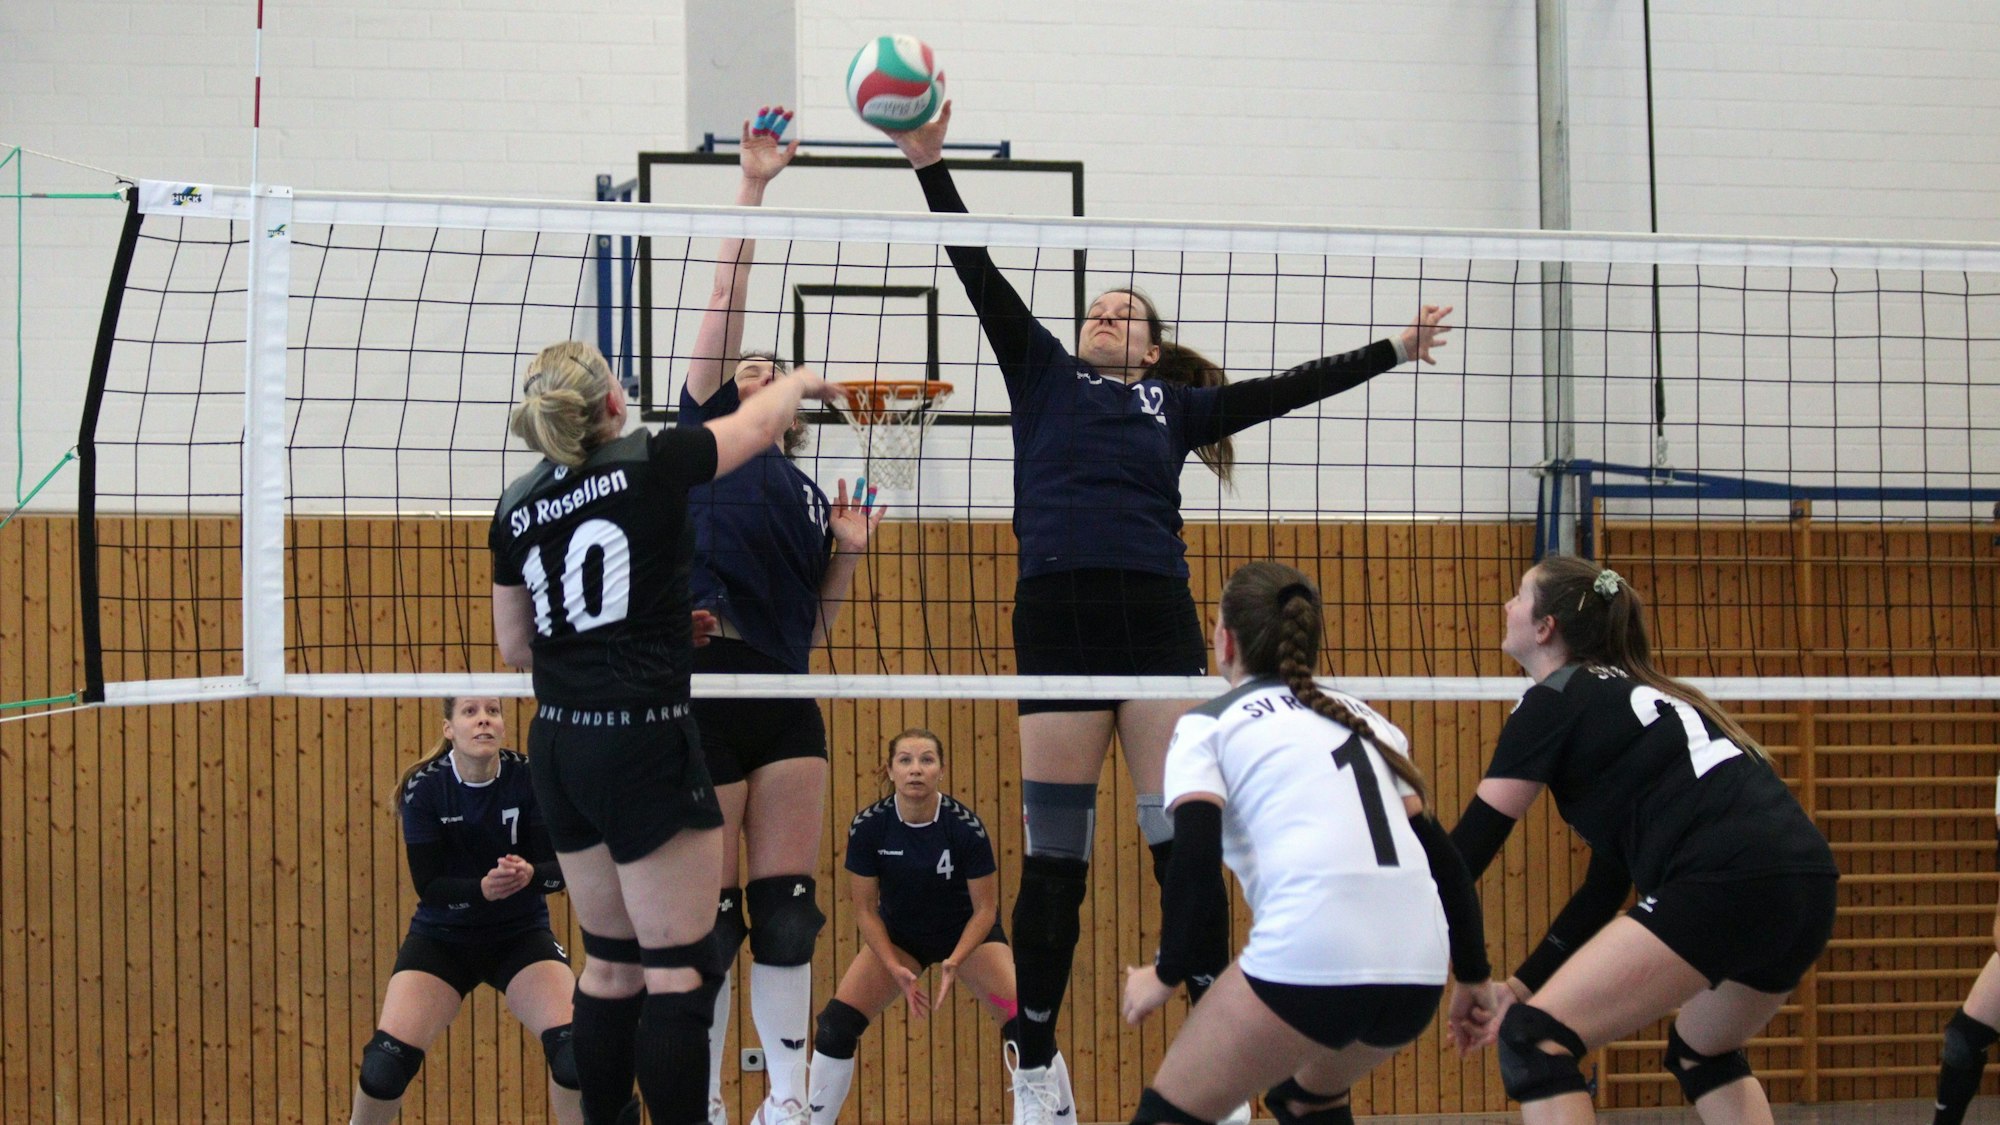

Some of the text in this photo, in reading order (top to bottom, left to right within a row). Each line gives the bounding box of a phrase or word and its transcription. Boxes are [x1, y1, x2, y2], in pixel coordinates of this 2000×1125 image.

[172, 192, 202, 203] HUCK
[1131, 383, 1167, 426] 12
[511, 469, 628, 538] SV Rosellen
[521, 518, 631, 637] 10
[572, 709, 631, 726] UNDER
[1243, 698, 1275, 718] SV
[1630, 685, 1744, 779] 2
[1331, 733, 1400, 868] 1
[502, 807, 520, 845] 7
[936, 849, 954, 880] 4
